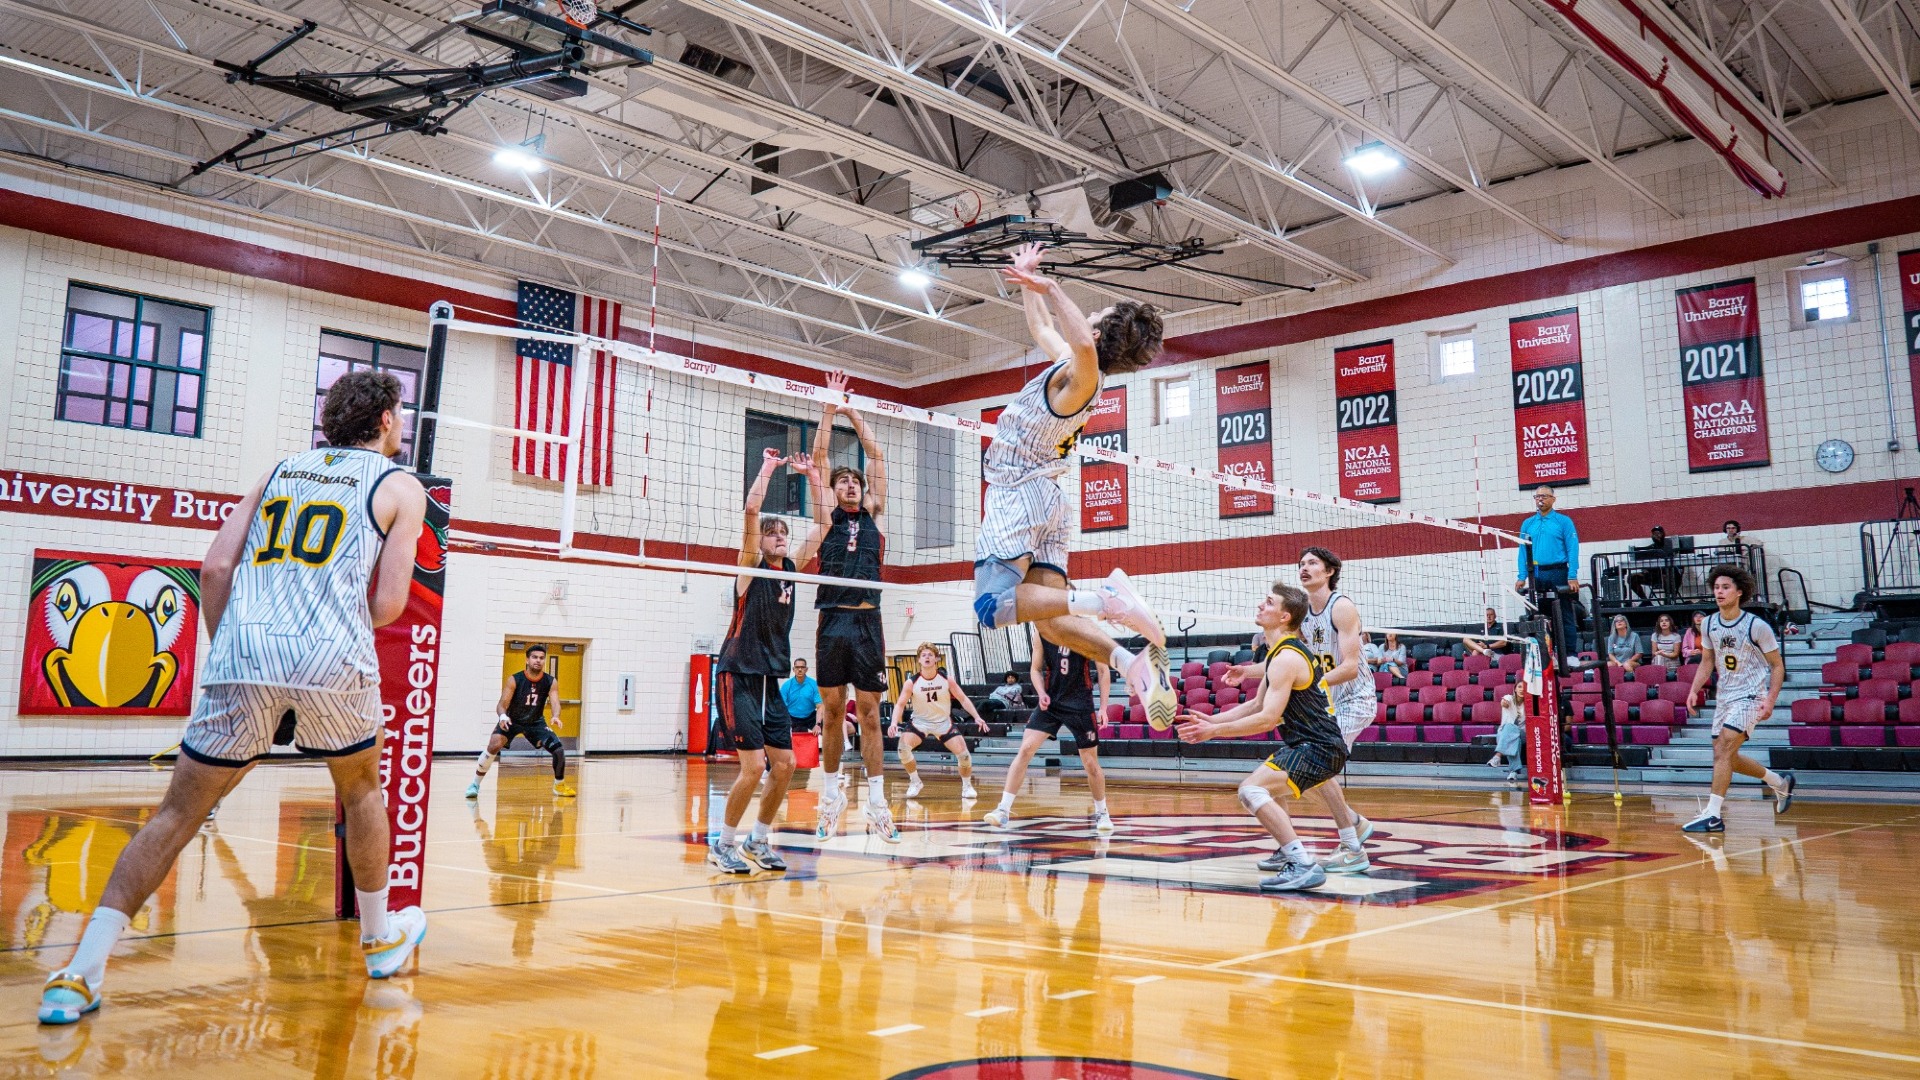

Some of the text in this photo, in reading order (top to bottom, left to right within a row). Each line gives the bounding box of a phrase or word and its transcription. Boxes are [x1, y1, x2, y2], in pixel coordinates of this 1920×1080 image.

[1708, 295, 1745, 310] Barry
[1684, 304, 1747, 323] University
[1538, 324, 1570, 337] Barry
[1517, 332, 1572, 349] University
[684, 358, 717, 374] BarryU
[1358, 354, 1386, 366] Barry
[1685, 342, 1747, 382] 2021
[1340, 361, 1388, 377] University
[1237, 374, 1263, 385] Barry
[1517, 367, 1575, 405] 2022
[785, 380, 816, 395] BarryU
[1221, 381, 1264, 395] University
[876, 400, 903, 413] BarryU
[1098, 397, 1120, 407] Barry
[1340, 394, 1390, 429] 2022
[1692, 400, 1754, 421] NCAA
[957, 417, 981, 431] BarryU
[1221, 412, 1266, 445] 2023
[1694, 414, 1756, 431] NATIONAL
[1522, 421, 1577, 441] NCAA
[1694, 425, 1757, 440] CHAMPIONS
[1523, 436, 1578, 450] NATIONAL
[1713, 442, 1737, 450] MEN'S
[1344, 444, 1391, 462] NCAA
[1524, 445, 1578, 458] CHAMPIONS
[1707, 448, 1744, 460] TENNIS
[1223, 461, 1266, 475] NCAA
[1345, 457, 1391, 470] NATIONAL
[1534, 461, 1567, 470] WOMEN'S
[279, 470, 360, 488] MERRIMACK
[1345, 466, 1392, 478] CHAMPIONS
[1535, 467, 1567, 478] TENNIS
[1085, 478, 1121, 493] NCAA
[1354, 487, 1381, 496] TENNIS
[1085, 490, 1122, 501] NATIONAL
[1085, 497, 1122, 508] CHAMPIONS
[1233, 500, 1257, 509] TENNIS
[252, 496, 348, 568] 10
[1060, 658, 1069, 675] 9
[1724, 653, 1737, 671] 9
[525, 694, 539, 706] 17
[926, 691, 938, 703] 14
[387, 624, 437, 890] Buccaneers
